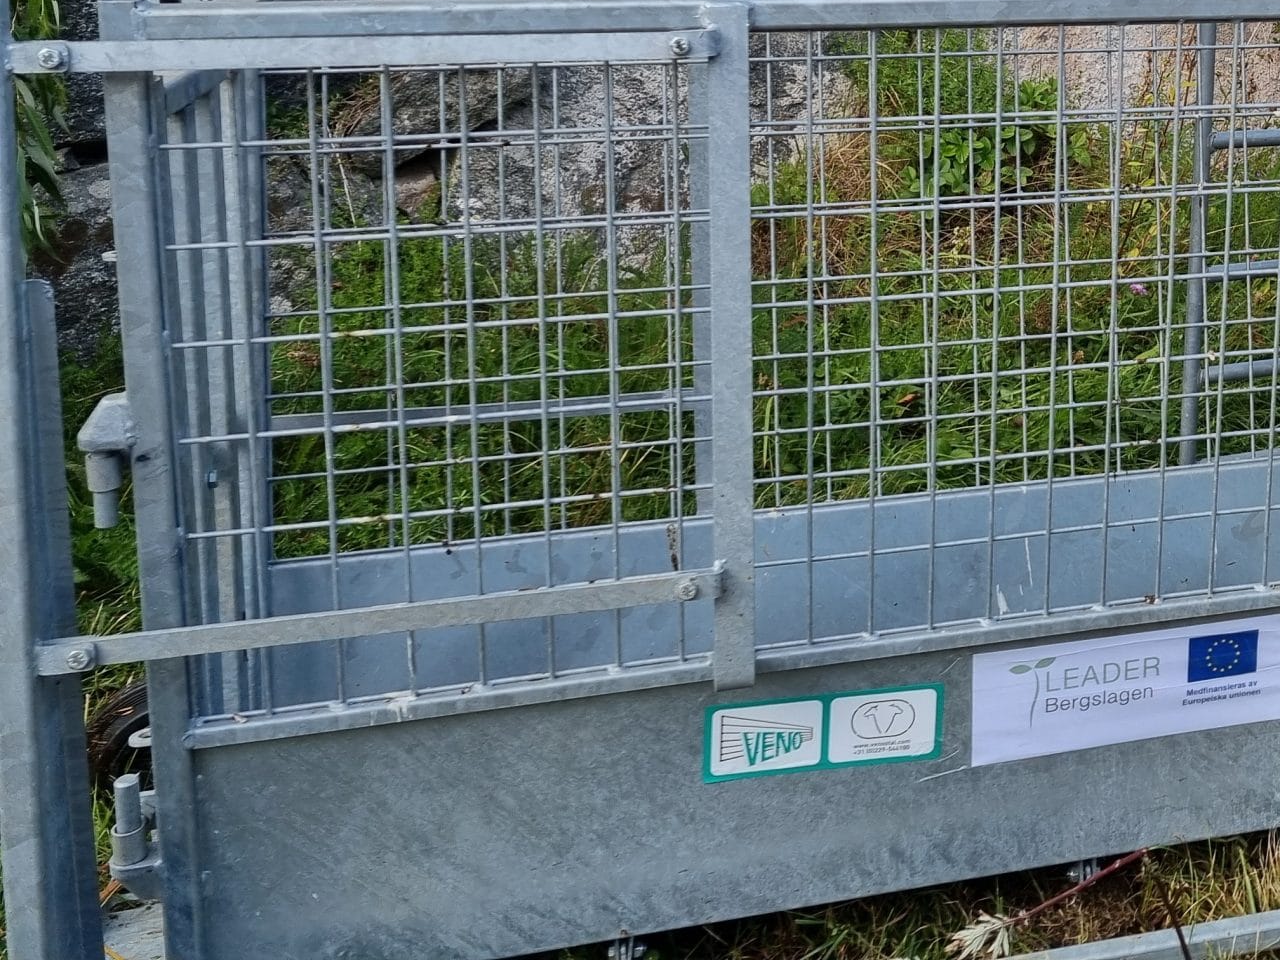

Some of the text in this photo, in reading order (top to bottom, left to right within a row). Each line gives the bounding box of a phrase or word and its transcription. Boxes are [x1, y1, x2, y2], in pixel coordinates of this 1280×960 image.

[1046, 656, 1160, 692] LEADER
[1045, 686, 1154, 713] Bergslagen
[1182, 689, 1261, 706] Europeiska unionen
[1186, 683, 1246, 696] Medfinansieras
[743, 731, 803, 766] VENO
